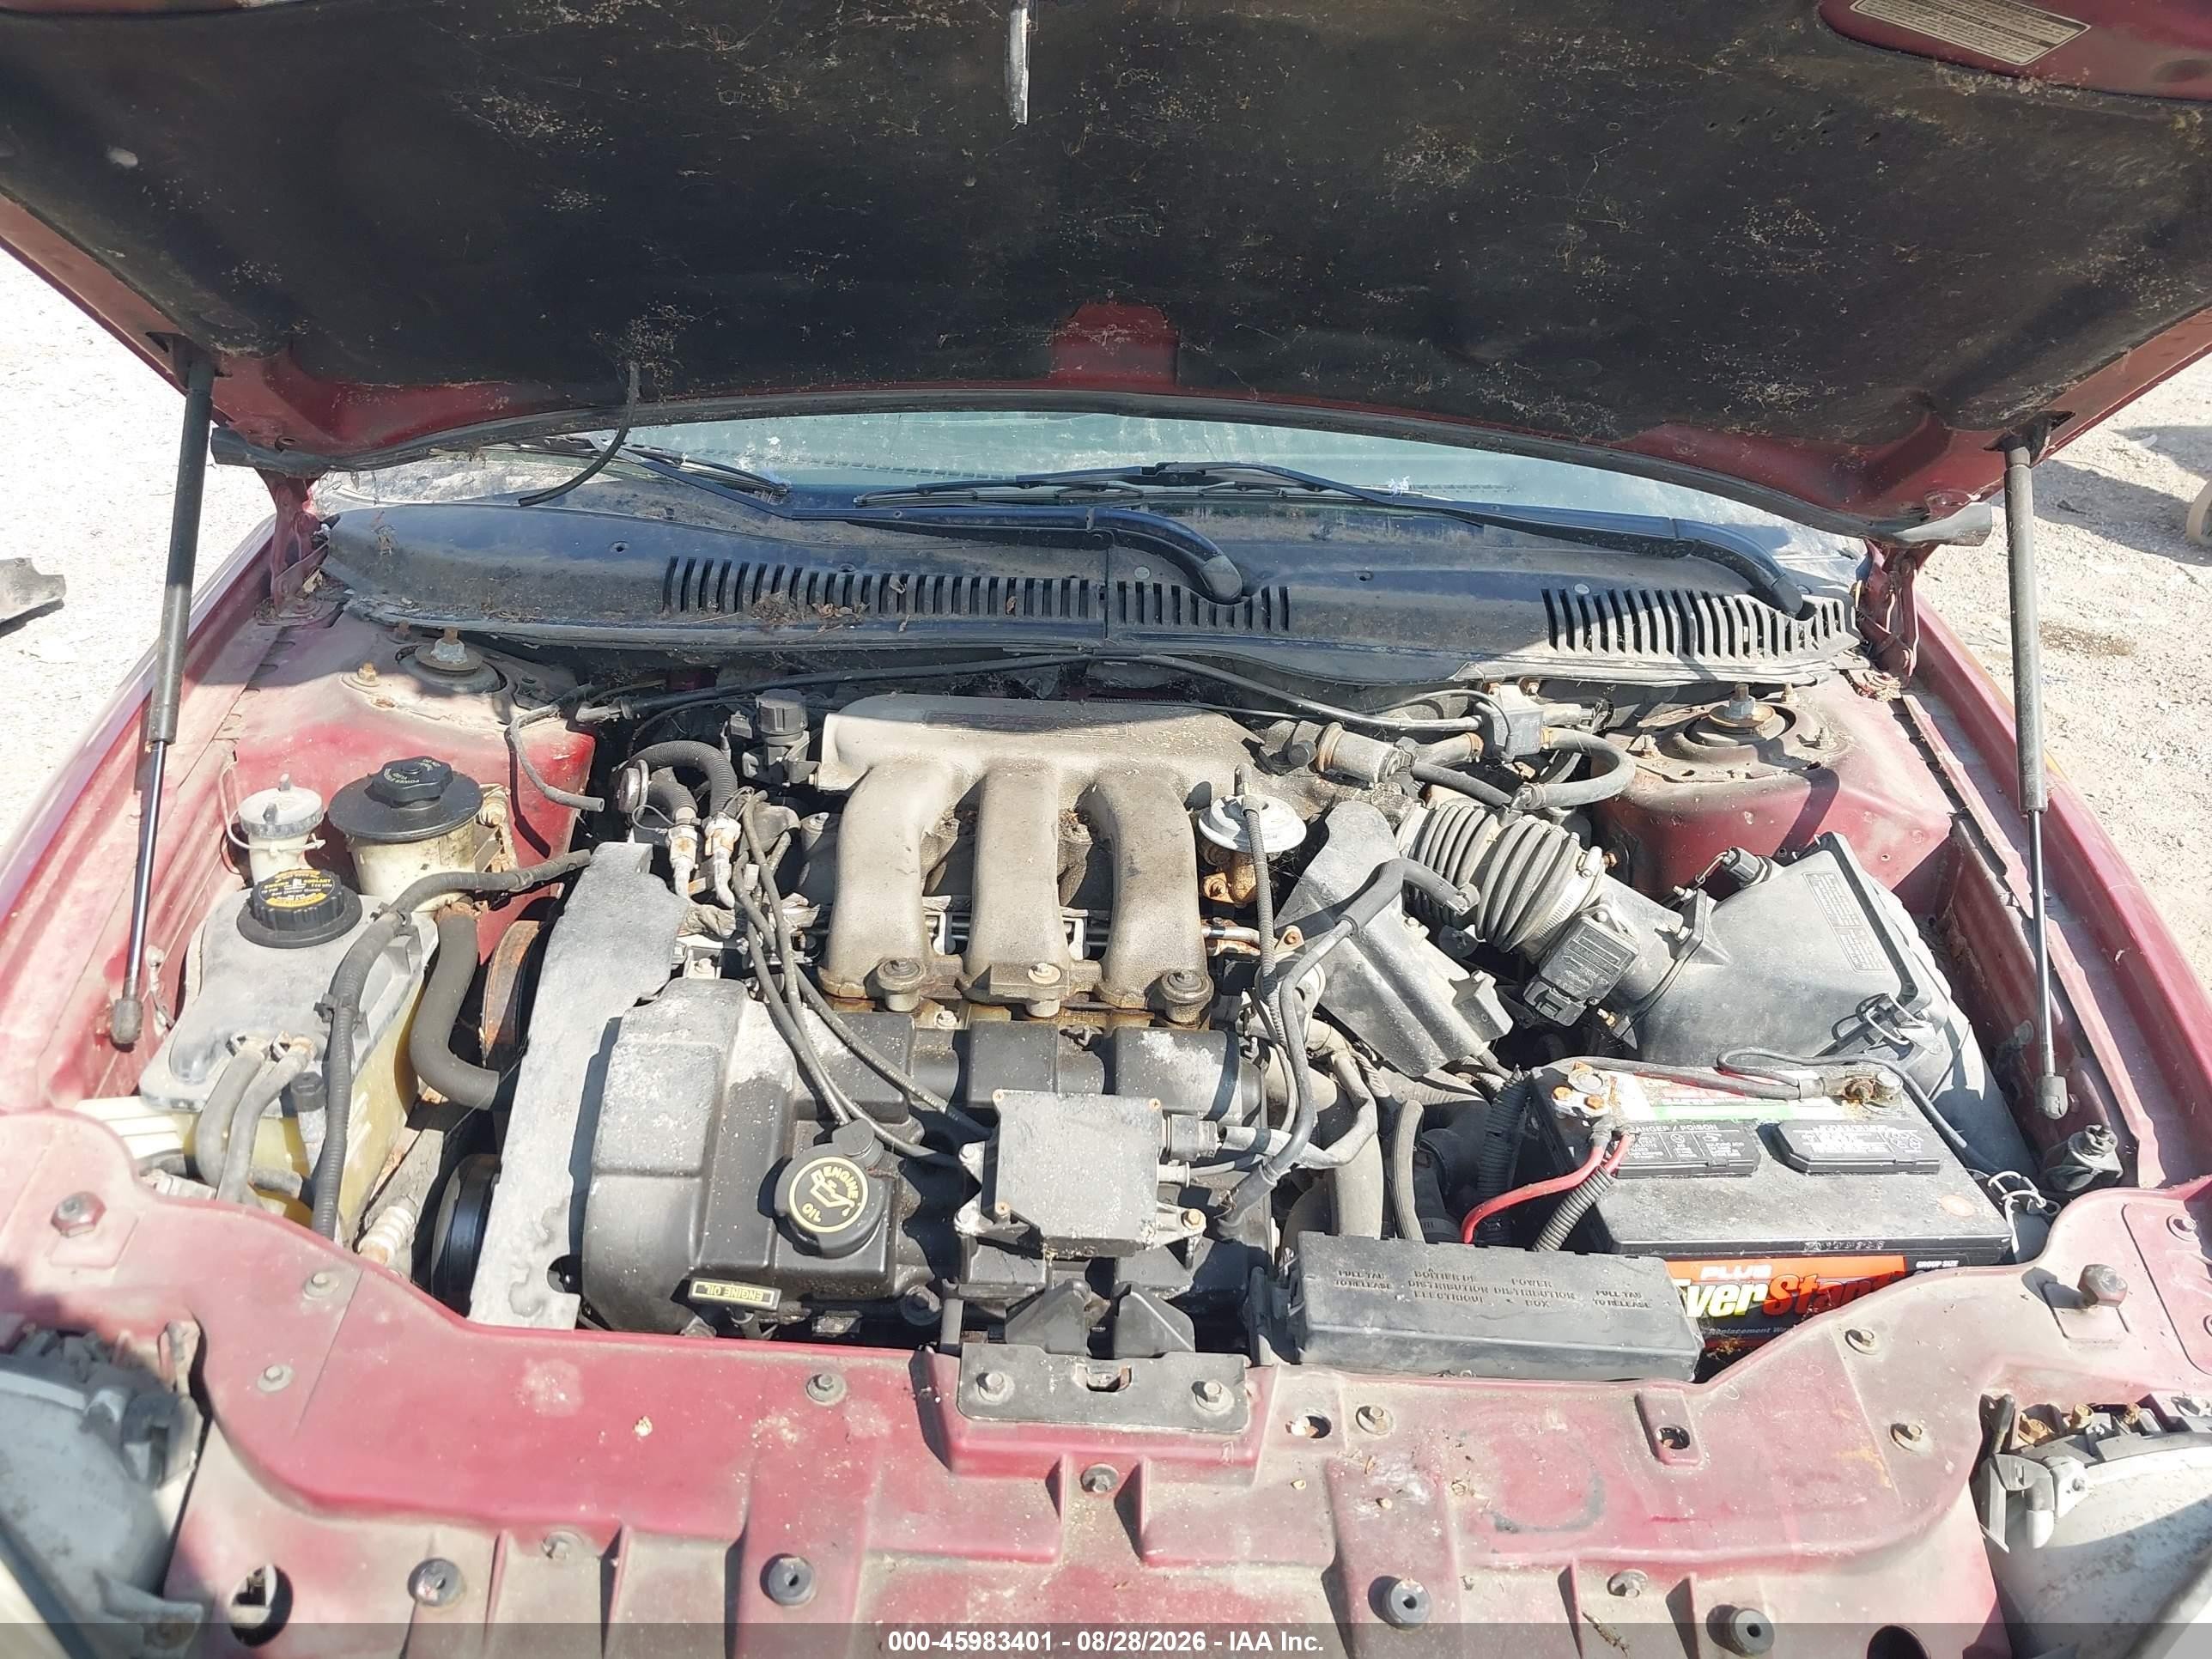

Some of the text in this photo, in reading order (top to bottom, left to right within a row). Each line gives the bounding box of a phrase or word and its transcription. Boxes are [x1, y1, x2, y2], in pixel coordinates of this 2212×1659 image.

[823, 1164, 859, 1200] ENGINE
[801, 1201, 822, 1223] OIL
[1915, 1260, 1942, 1269] GROUP
[1699, 1265, 1772, 1279] PLUS
[1407, 1279, 1490, 1294] DISTRIBUTION
[1510, 1277, 1553, 1288] POWER
[705, 1285, 764, 1302] ENGINE OIL
[1493, 1286, 1577, 1300] DISTRIBUTION
[1525, 1299, 1550, 1308] BOX
[1592, 1297, 1651, 1309] TO RELEASE
